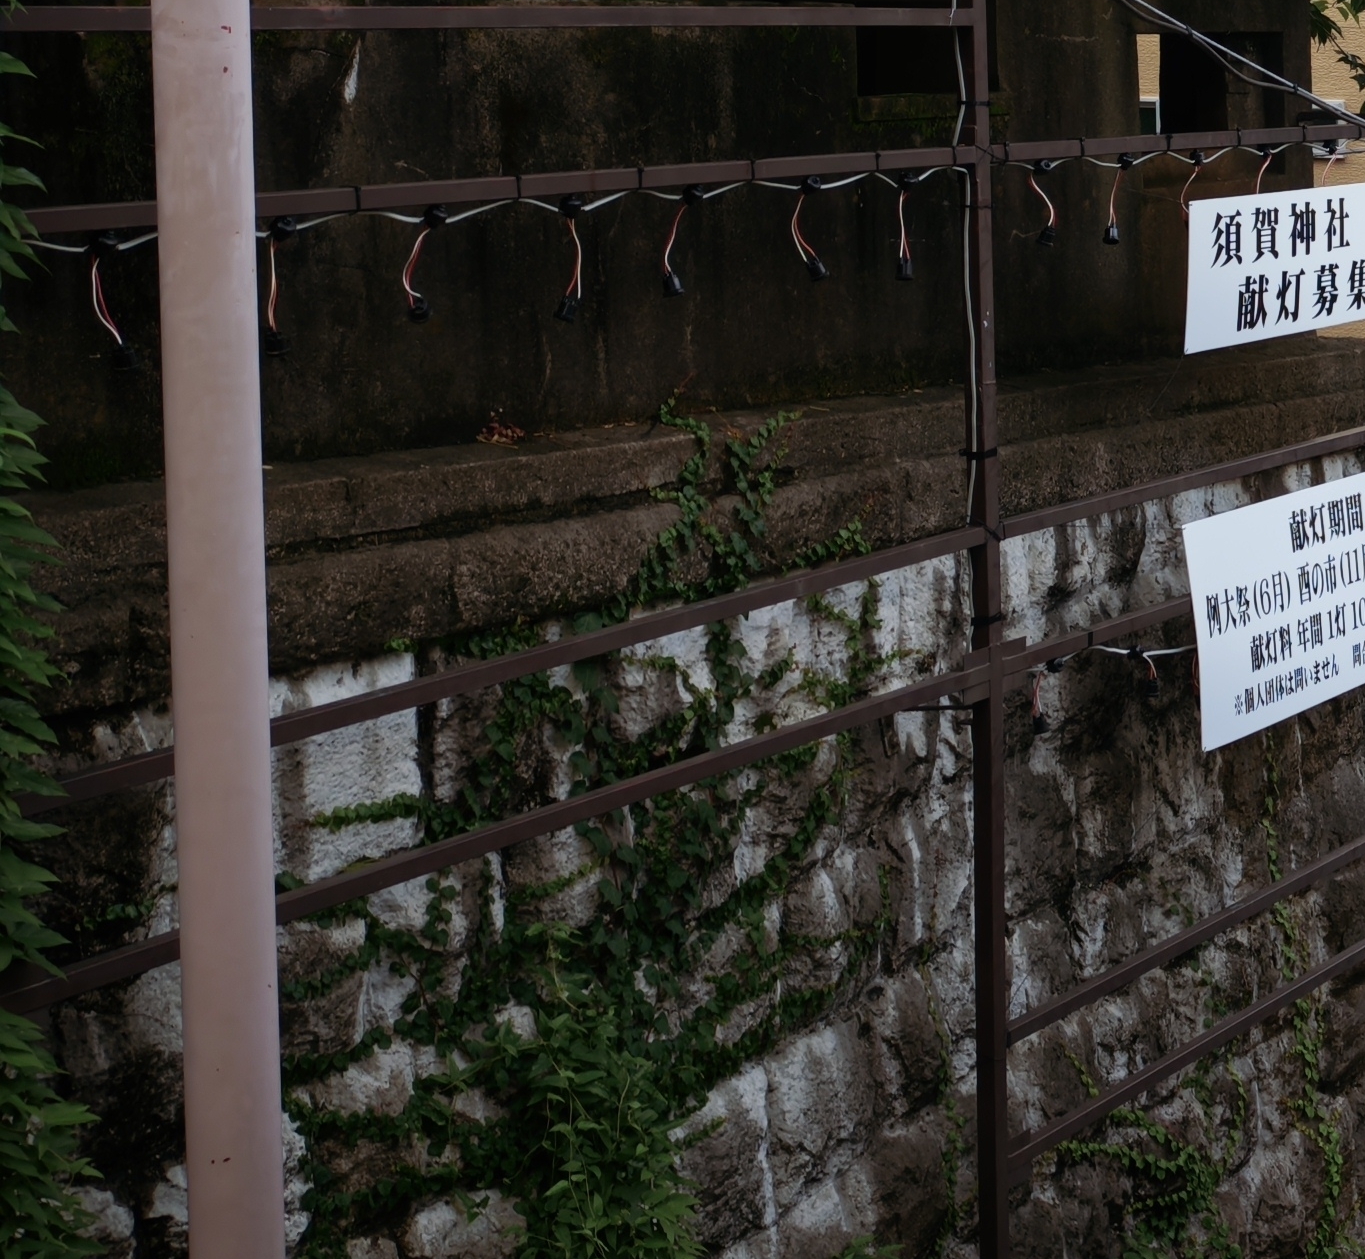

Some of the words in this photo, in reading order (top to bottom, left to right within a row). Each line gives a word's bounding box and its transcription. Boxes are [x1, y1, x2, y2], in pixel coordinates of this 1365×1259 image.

[1210, 197, 1351, 269] 須賀神社
[1288, 492, 1364, 553] 献灯期間
[1250, 623, 1292, 672] 献灯料
[1296, 611, 1323, 653] 年間
[1327, 603, 1346, 640] 1灯
